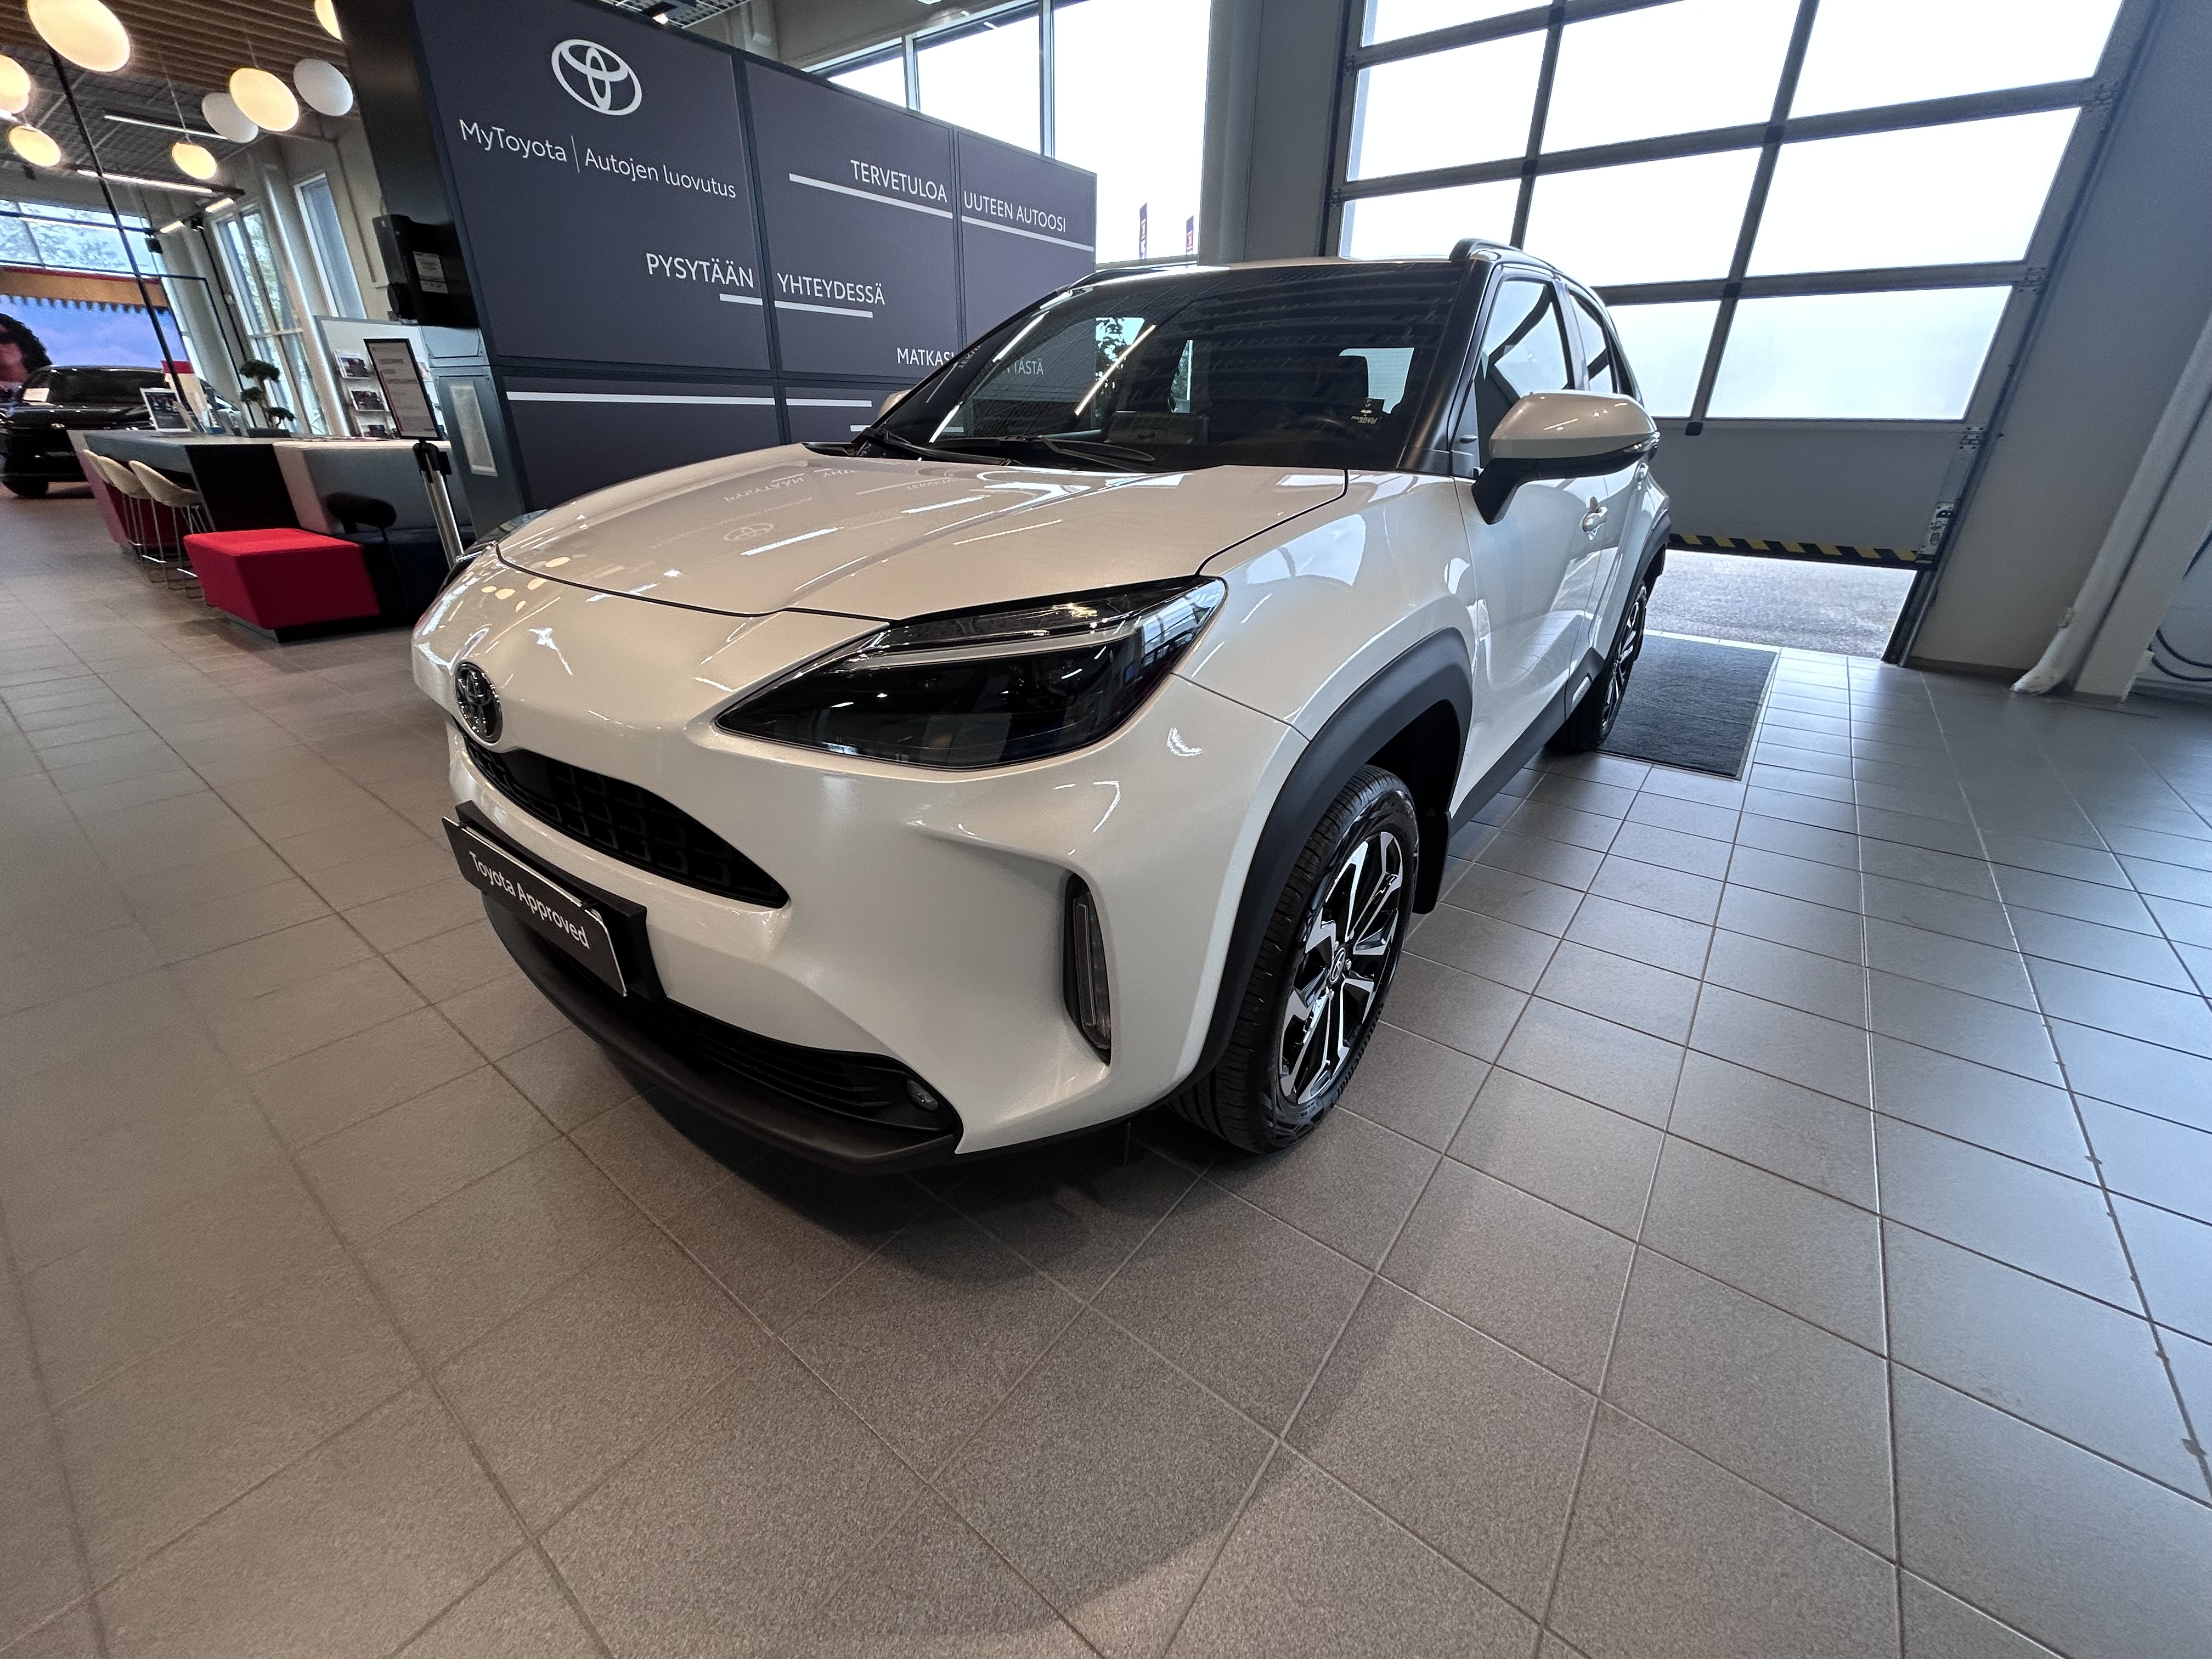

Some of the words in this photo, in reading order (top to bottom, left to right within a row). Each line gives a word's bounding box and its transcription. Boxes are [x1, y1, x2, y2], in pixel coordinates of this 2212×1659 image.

[459, 119, 567, 162] MyToyota
[585, 148, 659, 182] Autojen
[663, 165, 736, 199] luovutus
[850, 159, 947, 203] TERVETULOA
[964, 190, 1013, 219] UUTEEN
[1016, 206, 1065, 233] AUTOOSI
[646, 252, 754, 287] PYSYTÄÄN
[777, 273, 885, 305] YHTEYDESSÄ
[469, 850, 516, 897] Toyota
[517, 882, 590, 949] Approved
